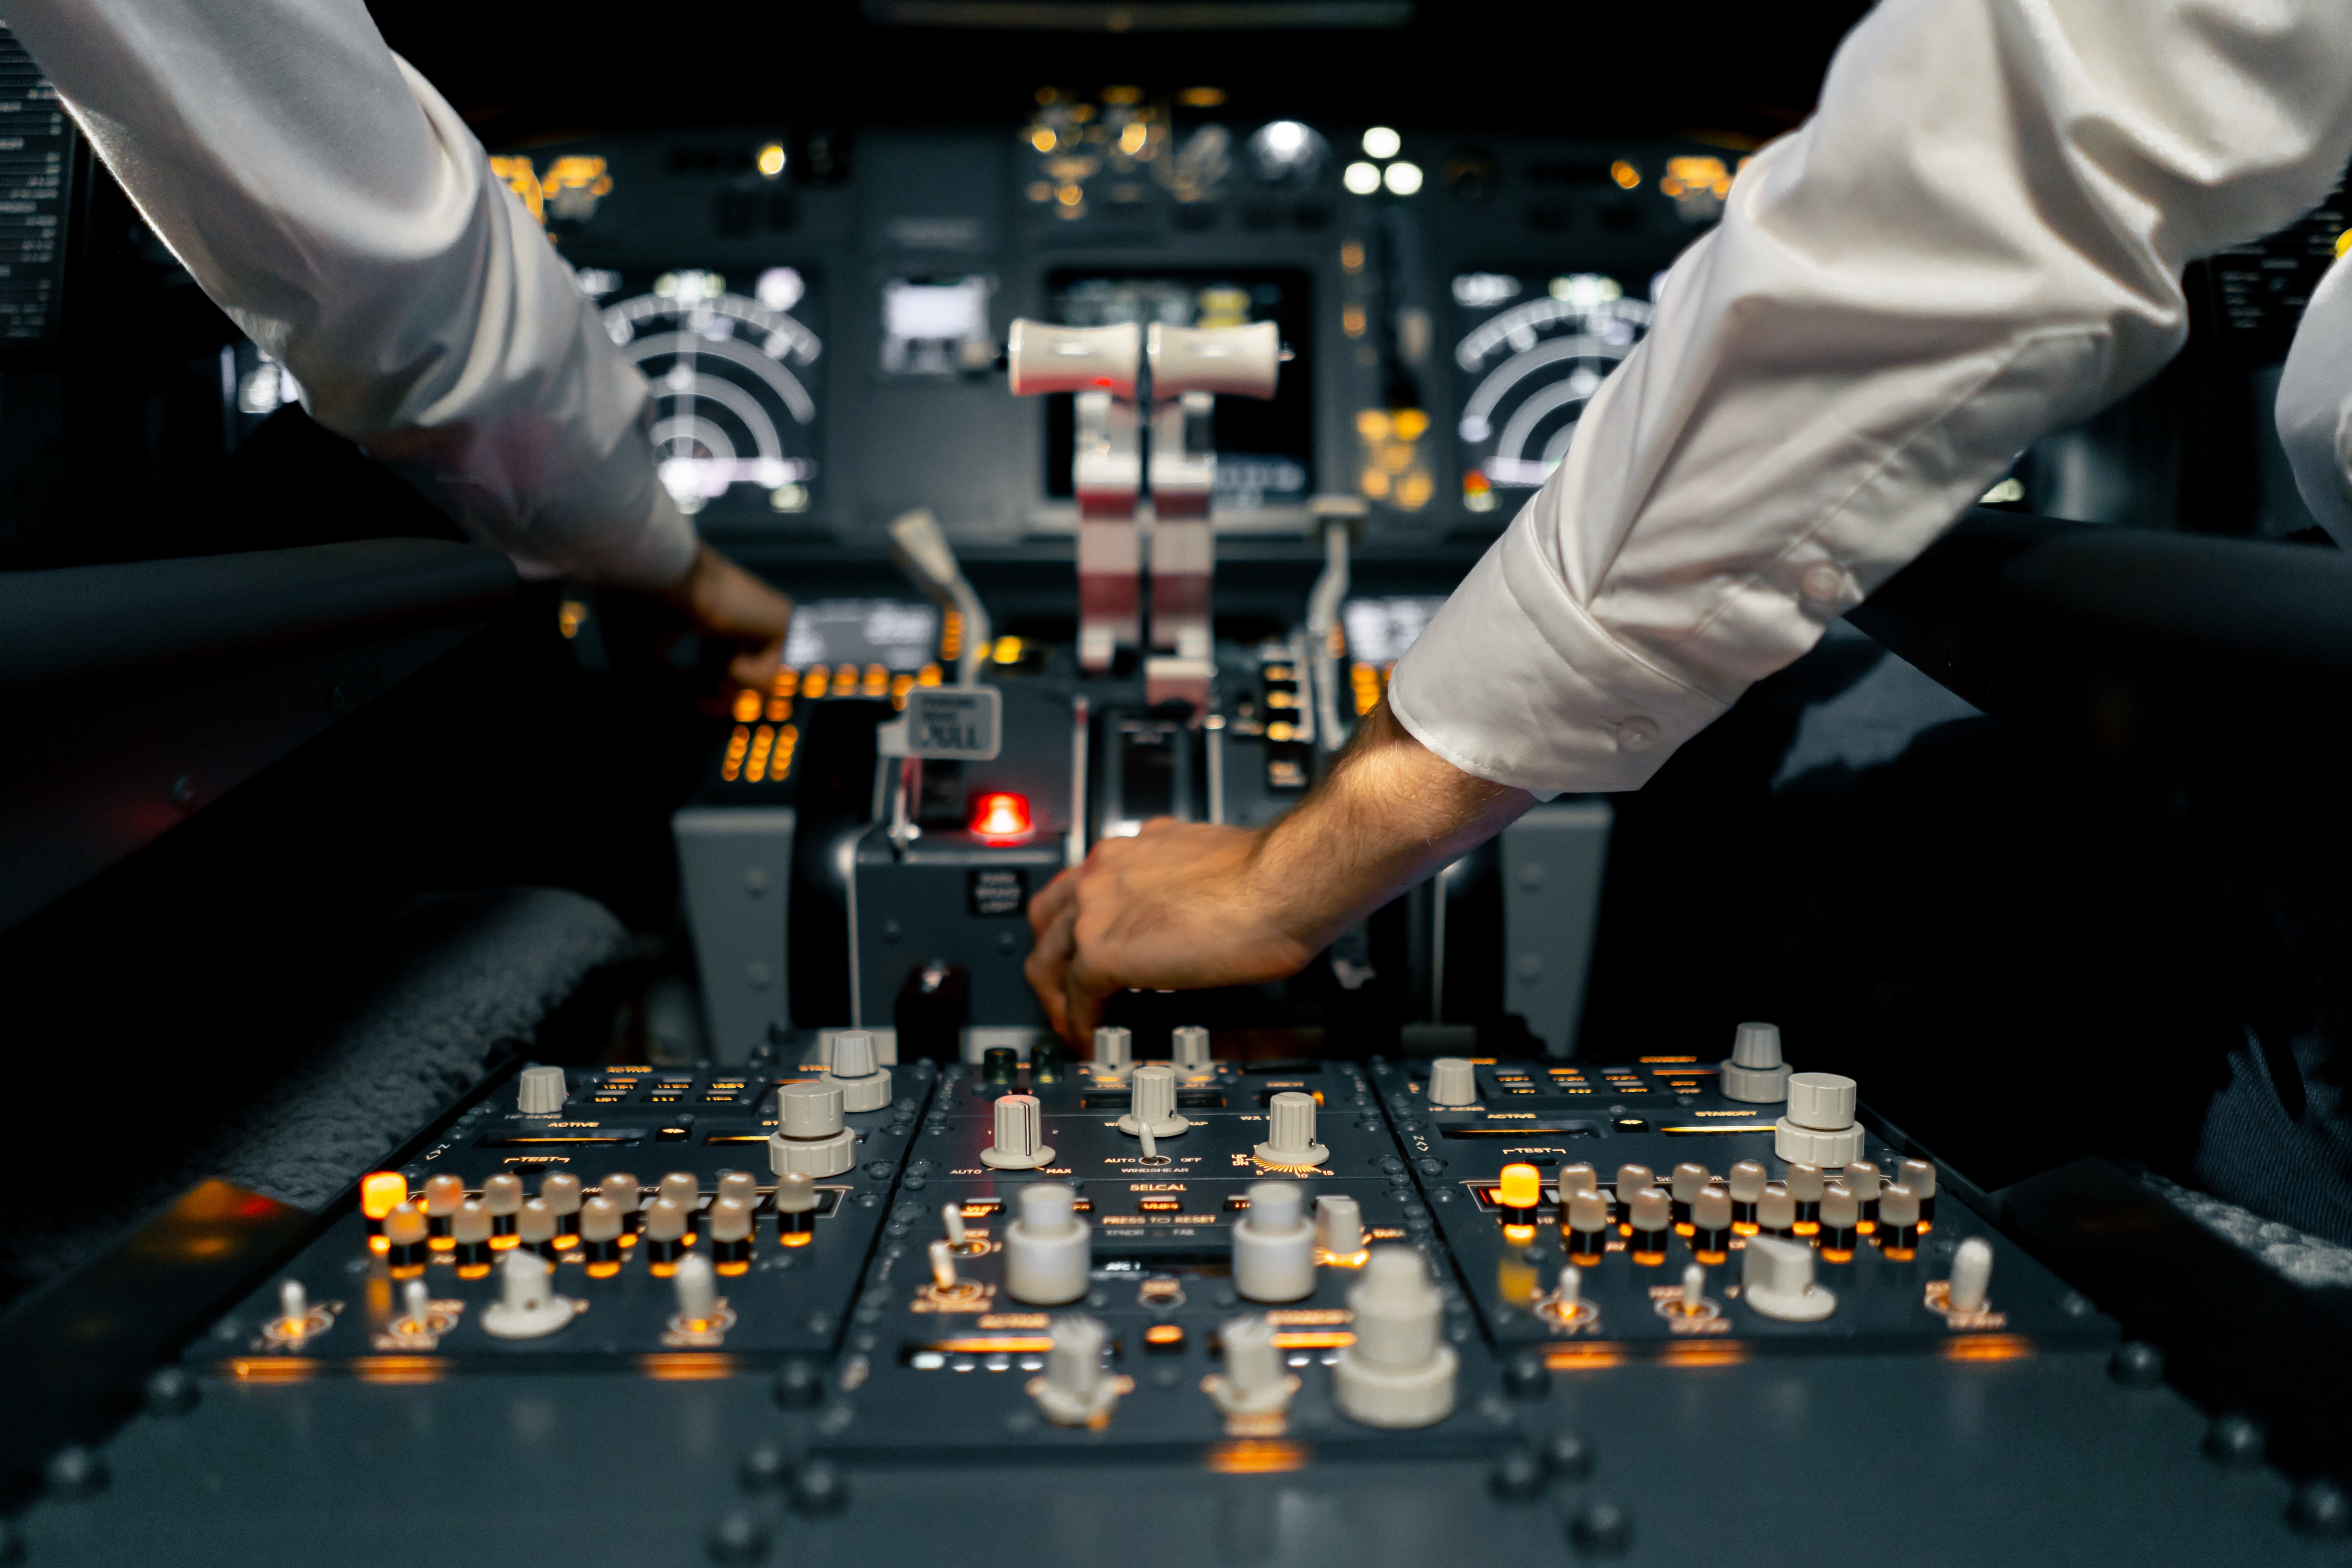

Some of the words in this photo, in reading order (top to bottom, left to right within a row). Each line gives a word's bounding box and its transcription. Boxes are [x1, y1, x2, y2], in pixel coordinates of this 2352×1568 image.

[1413, 1135, 1429, 1152] NAV
[1130, 1183, 1187, 1191] SELCAL
[1102, 1216, 1146, 1225] PRESS
[1174, 1215, 1216, 1224] RESET
